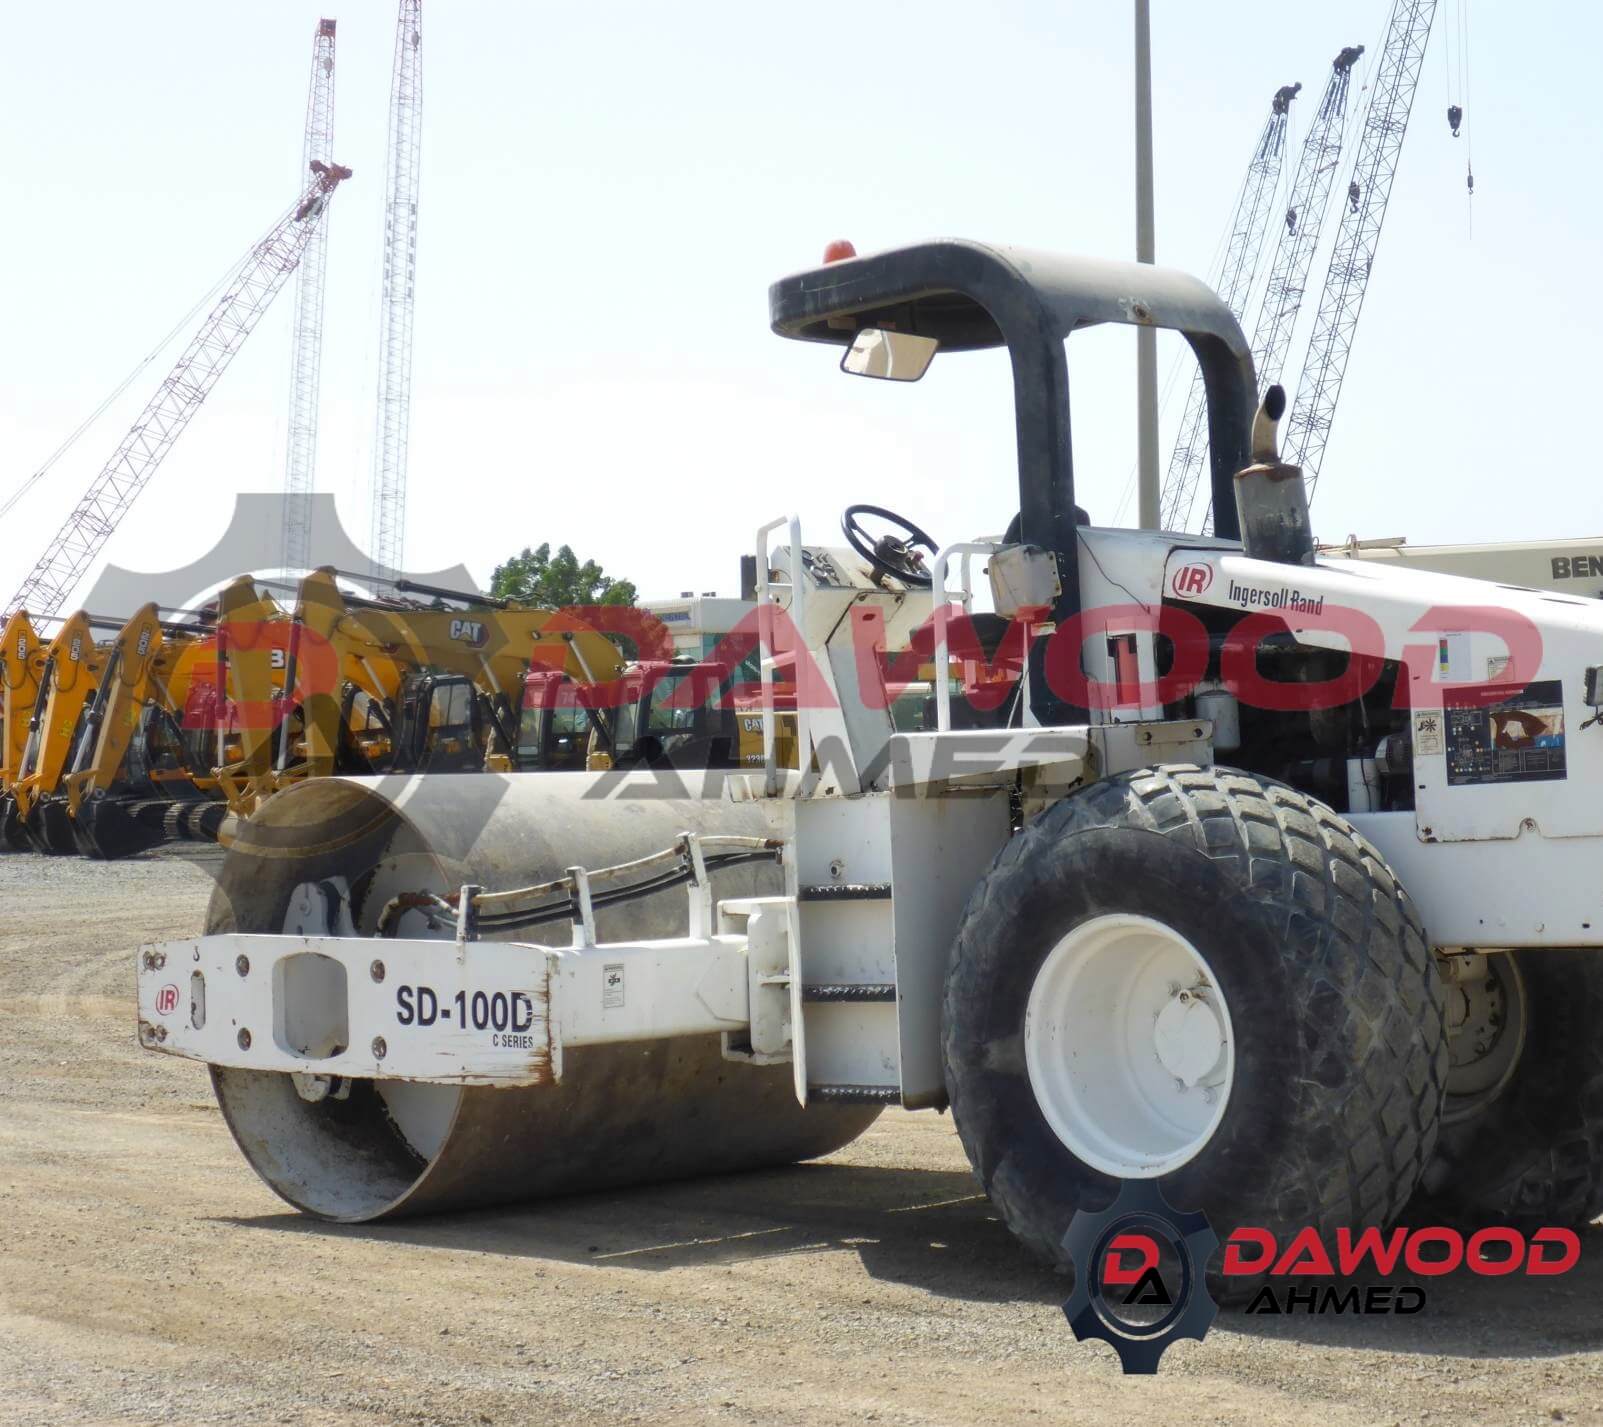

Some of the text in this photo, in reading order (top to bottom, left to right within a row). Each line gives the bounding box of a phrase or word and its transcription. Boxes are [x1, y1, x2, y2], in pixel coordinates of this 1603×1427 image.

[1551, 555, 1603, 579] BEN
[1228, 579, 1324, 616] Ingersoll Rand
[450, 619, 482, 642] CAT
[396, 985, 533, 1032] SD-100D
[492, 1033, 534, 1049] C SERIES
